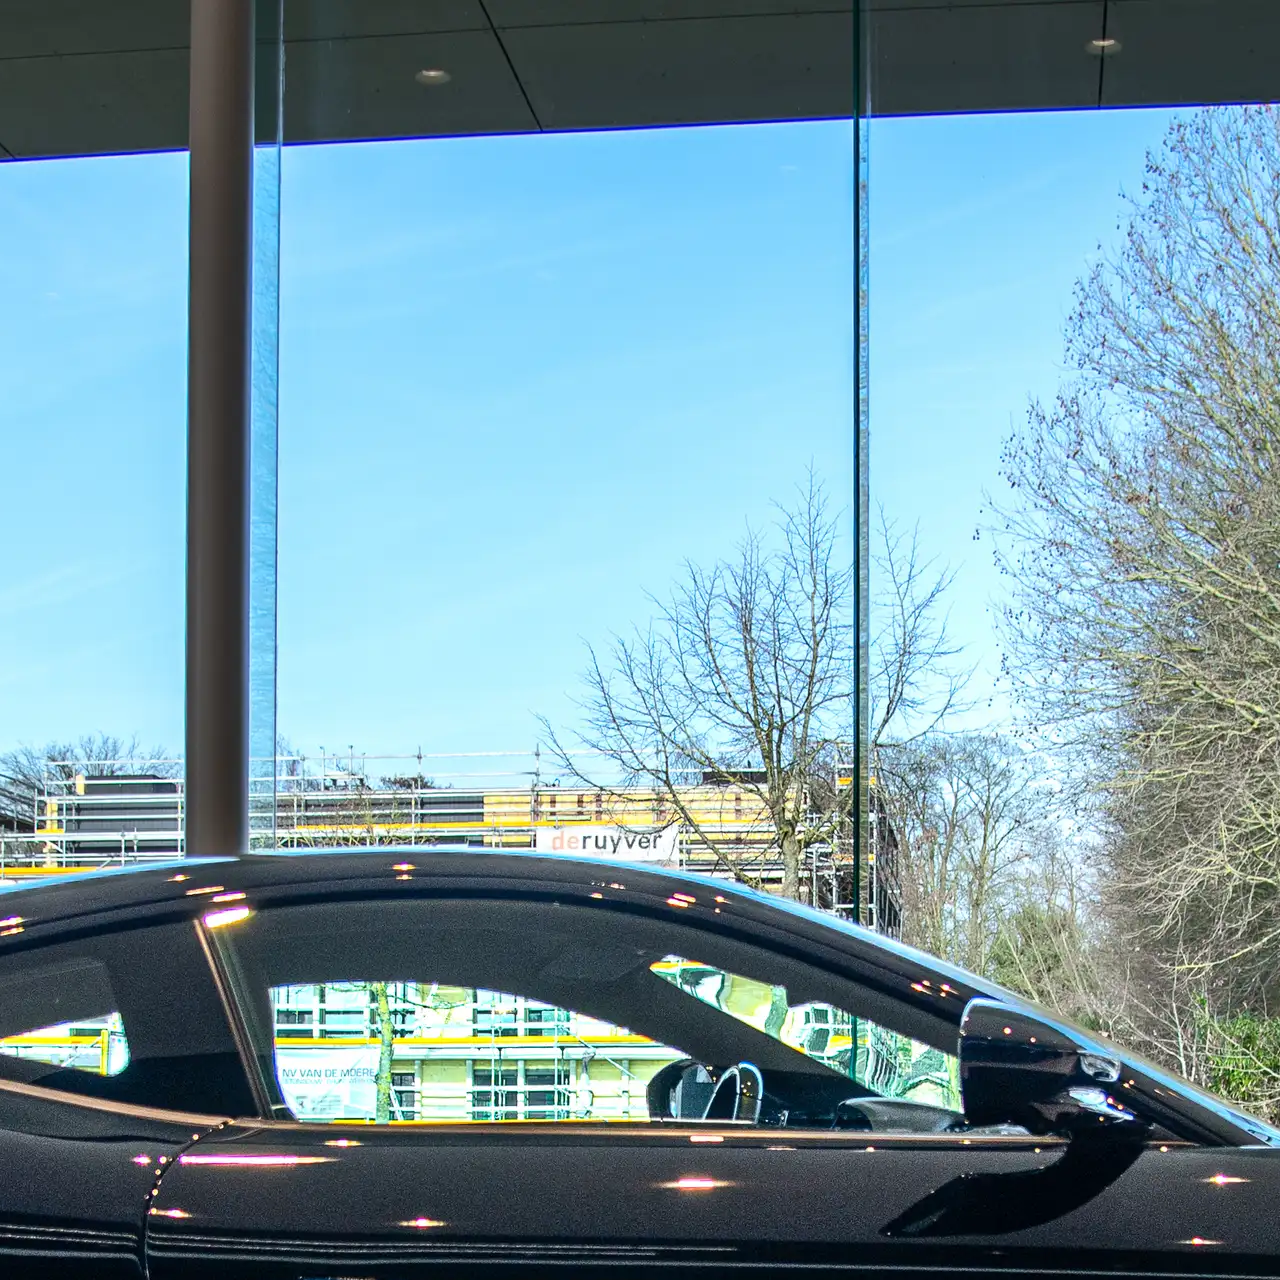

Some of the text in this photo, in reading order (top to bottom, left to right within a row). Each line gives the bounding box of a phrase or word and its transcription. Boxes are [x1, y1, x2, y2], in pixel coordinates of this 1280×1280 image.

[551, 831, 663, 853] deruyver
[282, 1068, 375, 1078] NV VAN DE MOERE
